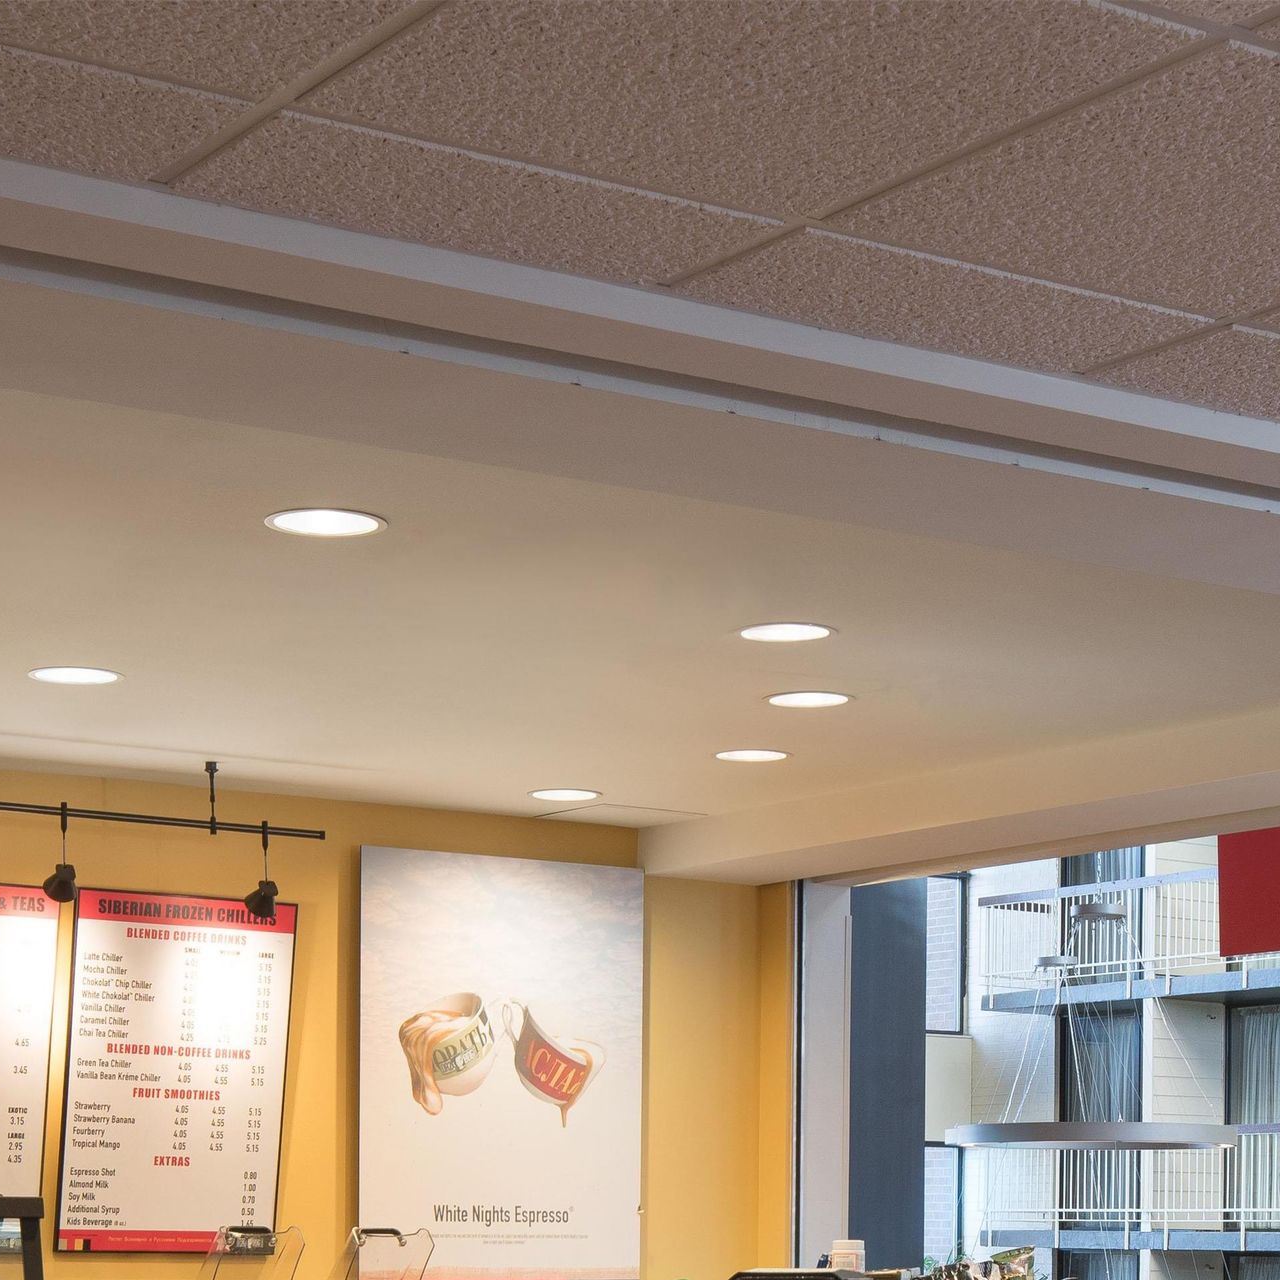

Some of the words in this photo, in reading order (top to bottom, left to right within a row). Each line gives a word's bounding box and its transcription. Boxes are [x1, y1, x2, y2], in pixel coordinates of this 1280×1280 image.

[12, 896, 45, 912] TEAS
[99, 899, 161, 917] SIBERIAN
[166, 903, 213, 921] FROZEN
[127, 927, 170, 940] BLENDED
[173, 931, 207, 943] COFFEE
[102, 953, 123, 962] Chiller
[84, 966, 104, 974] Mocha
[106, 966, 128, 975] Chiller
[115, 980, 130, 990] Chip
[131, 980, 152, 990] Chiller
[135, 993, 155, 1003] Chiller
[81, 1004, 102, 1012] Vanilla
[104, 1004, 126, 1013] Chiller
[80, 1016, 107, 1024] Caramel
[108, 1017, 130, 1026] Chiller
[79, 1028, 94, 1036] Chai
[96, 1029, 106, 1038] Tea
[107, 1030, 128, 1038] Chiller
[107, 1043, 150, 1054] BLENDED
[153, 1045, 212, 1058] NON-COFFEE
[214, 1048, 250, 1060] DRINKS
[77, 1058, 96, 1066] Green
[98, 1059, 109, 1067] Tea
[110, 1060, 132, 1068] Chiller
[76, 1071, 98, 1080] Vanilla
[100, 1072, 116, 1080] Bean
[140, 1074, 160, 1082] Chiller
[132, 1088, 161, 1098] FRUIT
[163, 1089, 220, 1101] SMOOTHIES
[74, 1102, 111, 1112] Strawberry
[10, 1117, 24, 1126] 3.15
[74, 1114, 110, 1125] Strawberry
[112, 1116, 135, 1124] Banana
[73, 1127, 105, 1138] Fourberry
[8, 1142, 22, 1150] 2.95
[72, 1139, 98, 1150] Tropical
[99, 1140, 120, 1150] Mango
[8, 1155, 22, 1163] 4.35
[154, 1156, 190, 1167] EXTRAS
[70, 1167, 100, 1178] Espresso
[101, 1168, 116, 1176] Shot
[69, 1180, 94, 1188] Almond
[95, 1180, 108, 1188] Milk
[68, 1192, 80, 1202] Soy
[82, 1192, 96, 1200] Milk
[68, 1205, 100, 1213] Additional
[101, 1206, 120, 1216] Syrup
[434, 1205, 468, 1222] White
[472, 1205, 510, 1227] Nights
[67, 1217, 80, 1225] Kids
[83, 1218, 112, 1227] Beverage
